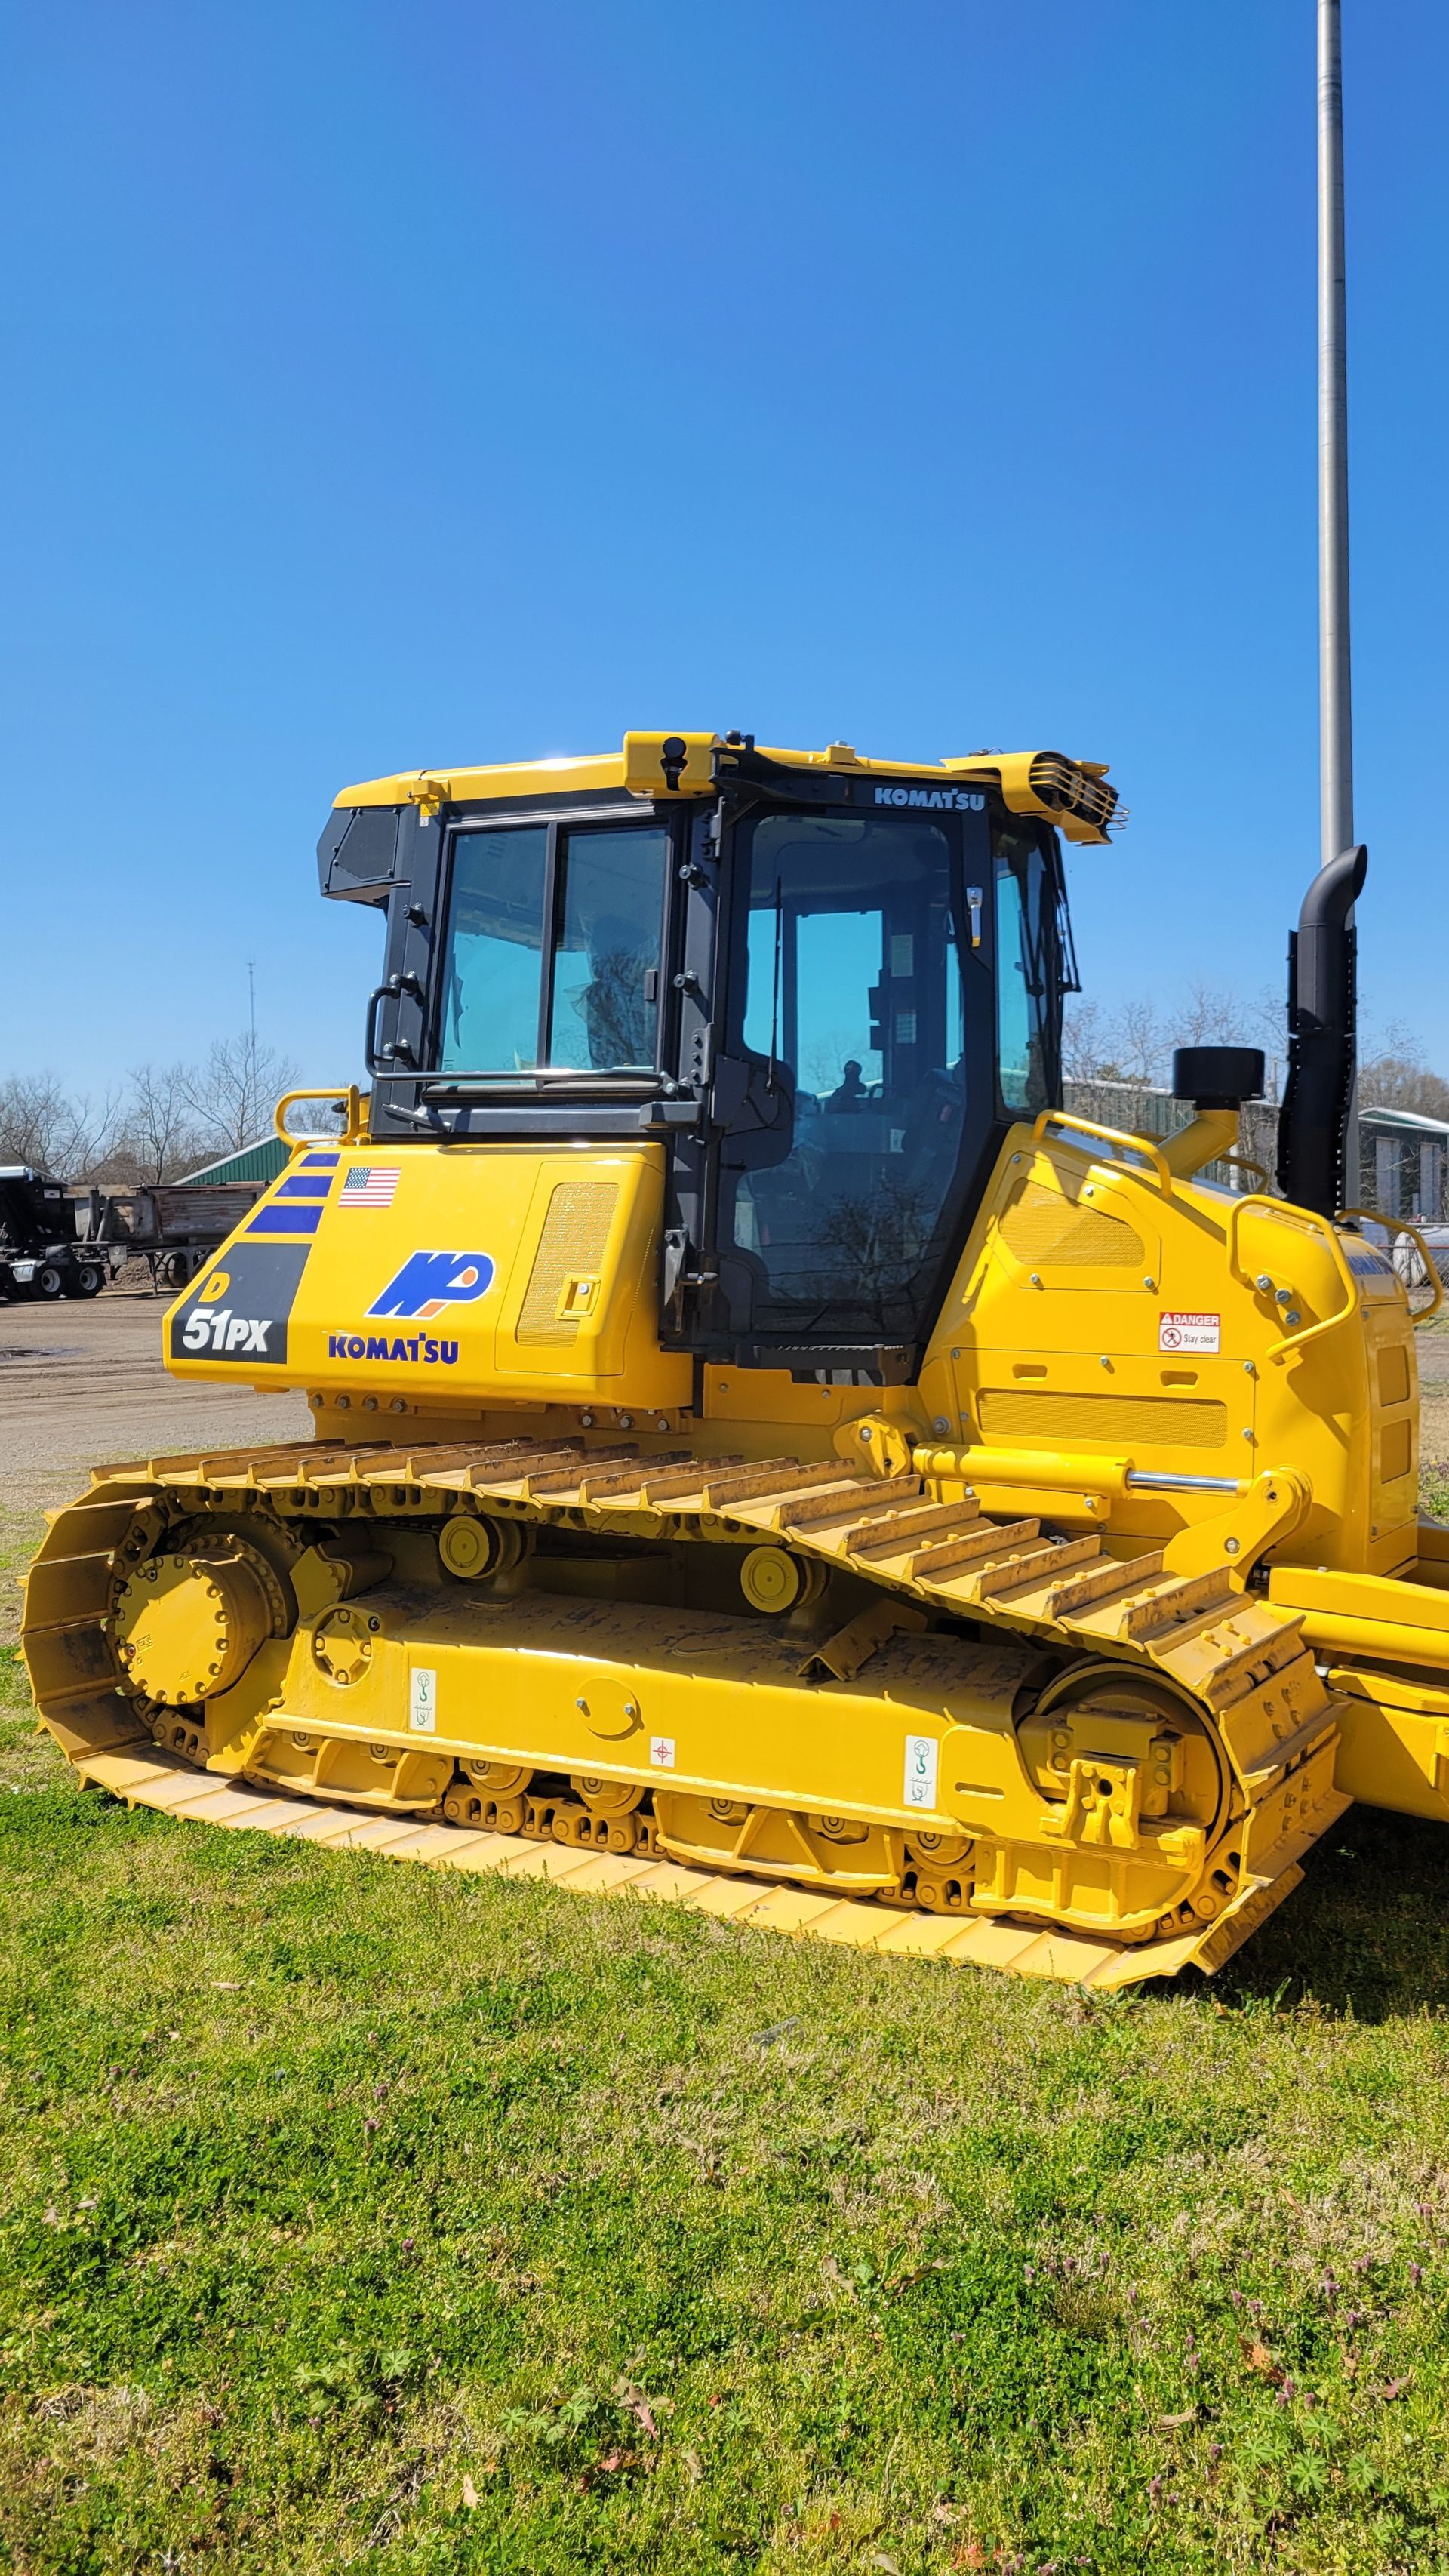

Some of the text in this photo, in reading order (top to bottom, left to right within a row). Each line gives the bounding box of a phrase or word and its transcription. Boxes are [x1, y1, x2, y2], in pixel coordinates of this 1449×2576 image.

[875, 787, 985, 811] KOMATSU
[198, 1272, 230, 1303] D
[183, 1308, 273, 1352] 51PX
[1173, 1314, 1219, 1325] DANGER
[328, 1332, 458, 1365] KOMATSU
[1183, 1334, 1216, 1345] Stay clear
